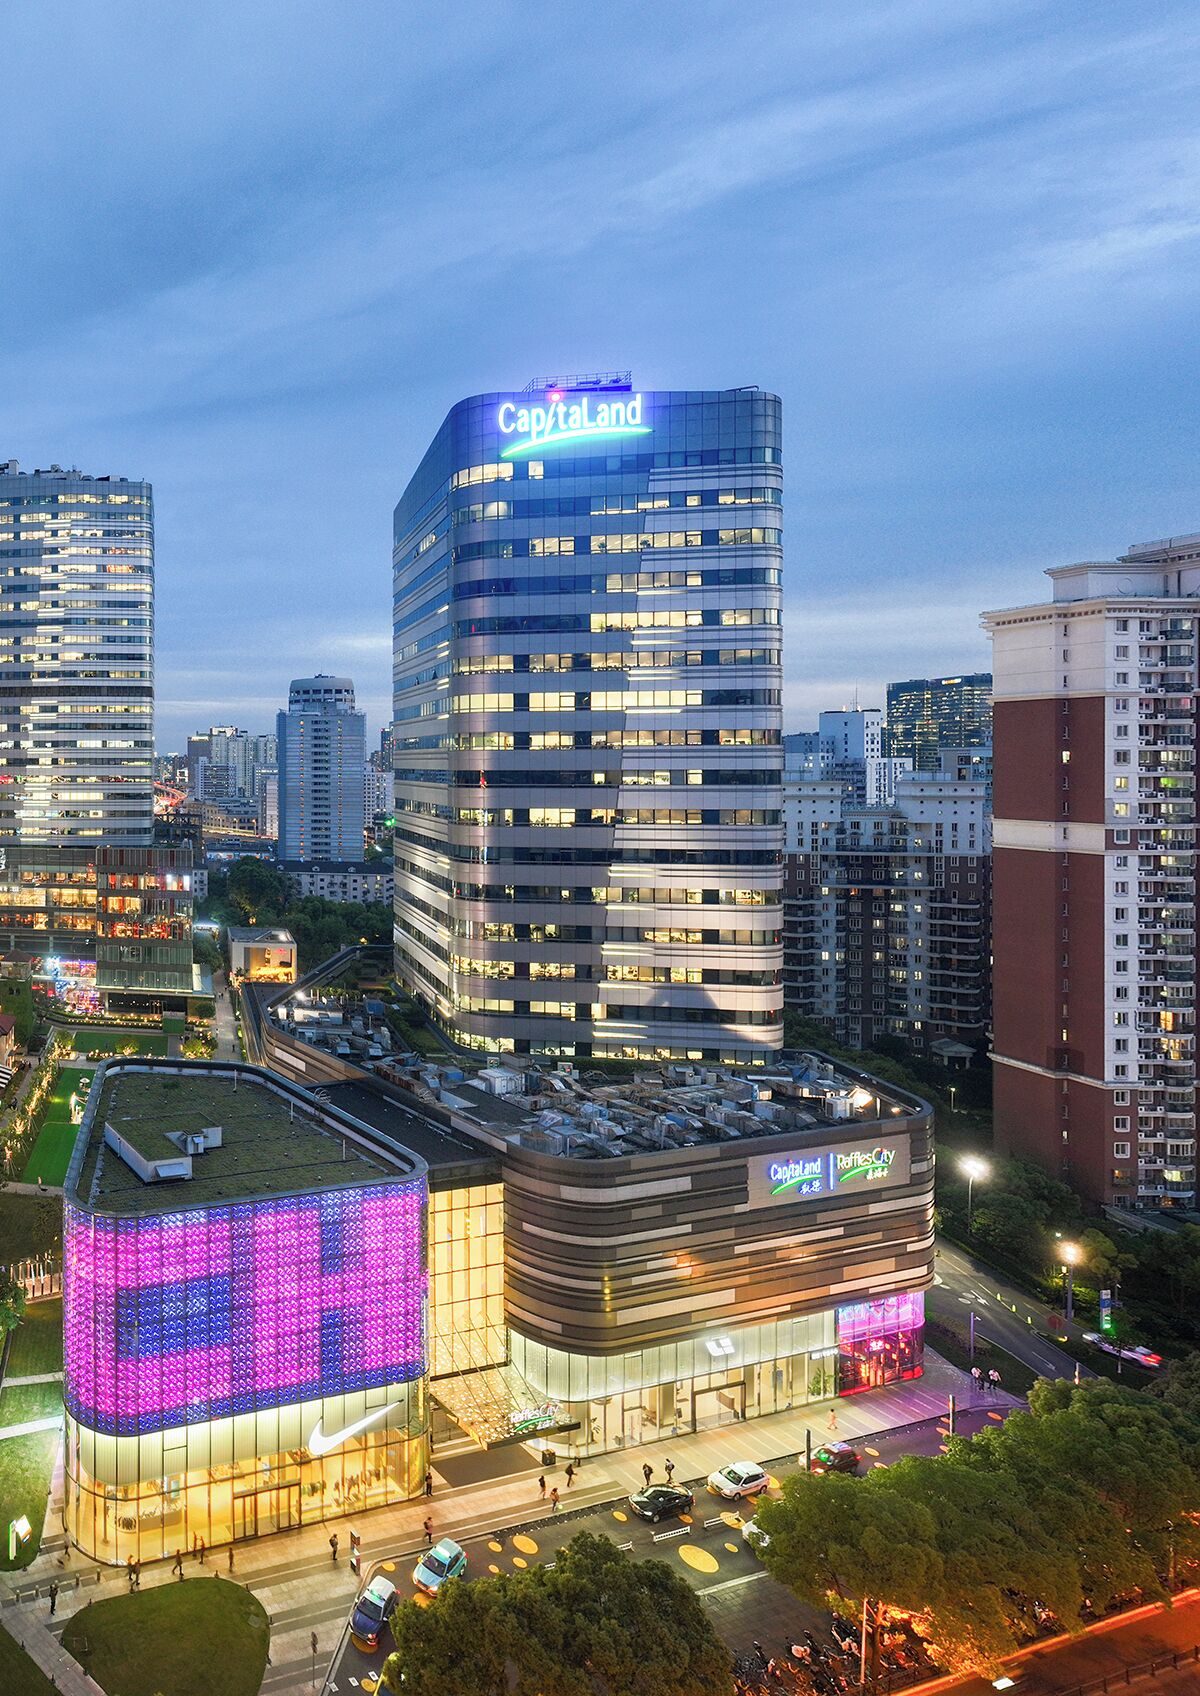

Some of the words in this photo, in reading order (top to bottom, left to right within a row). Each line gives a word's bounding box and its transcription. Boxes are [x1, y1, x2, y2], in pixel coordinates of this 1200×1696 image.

[498, 393, 642, 442] CapitaLand
[770, 1158, 821, 1183] CapitaLand
[836, 1152, 872, 1170] Raffles
[871, 1147, 895, 1165] City
